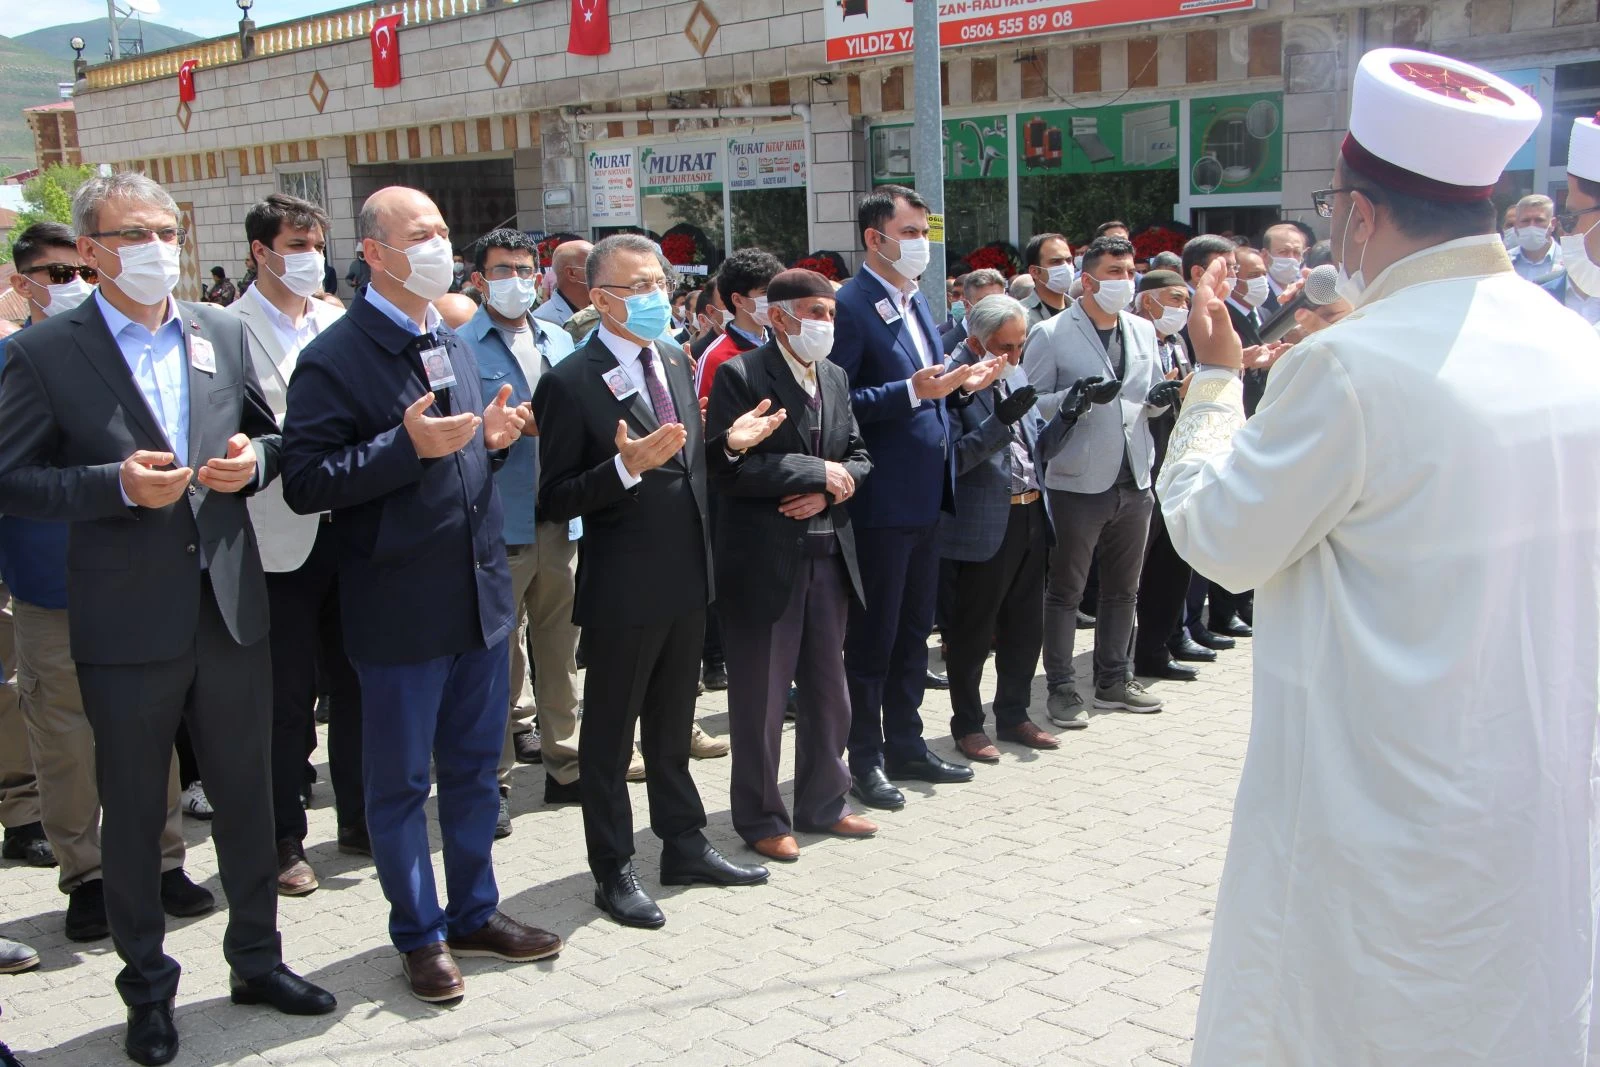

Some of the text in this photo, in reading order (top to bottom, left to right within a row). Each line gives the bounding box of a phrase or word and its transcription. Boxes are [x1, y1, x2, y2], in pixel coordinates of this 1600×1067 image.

[961, 10, 1073, 39] 0506 555 89 08
[733, 142, 764, 155] MURAT
[594, 154, 631, 169] MURAT
[649, 152, 717, 174] MURAT
